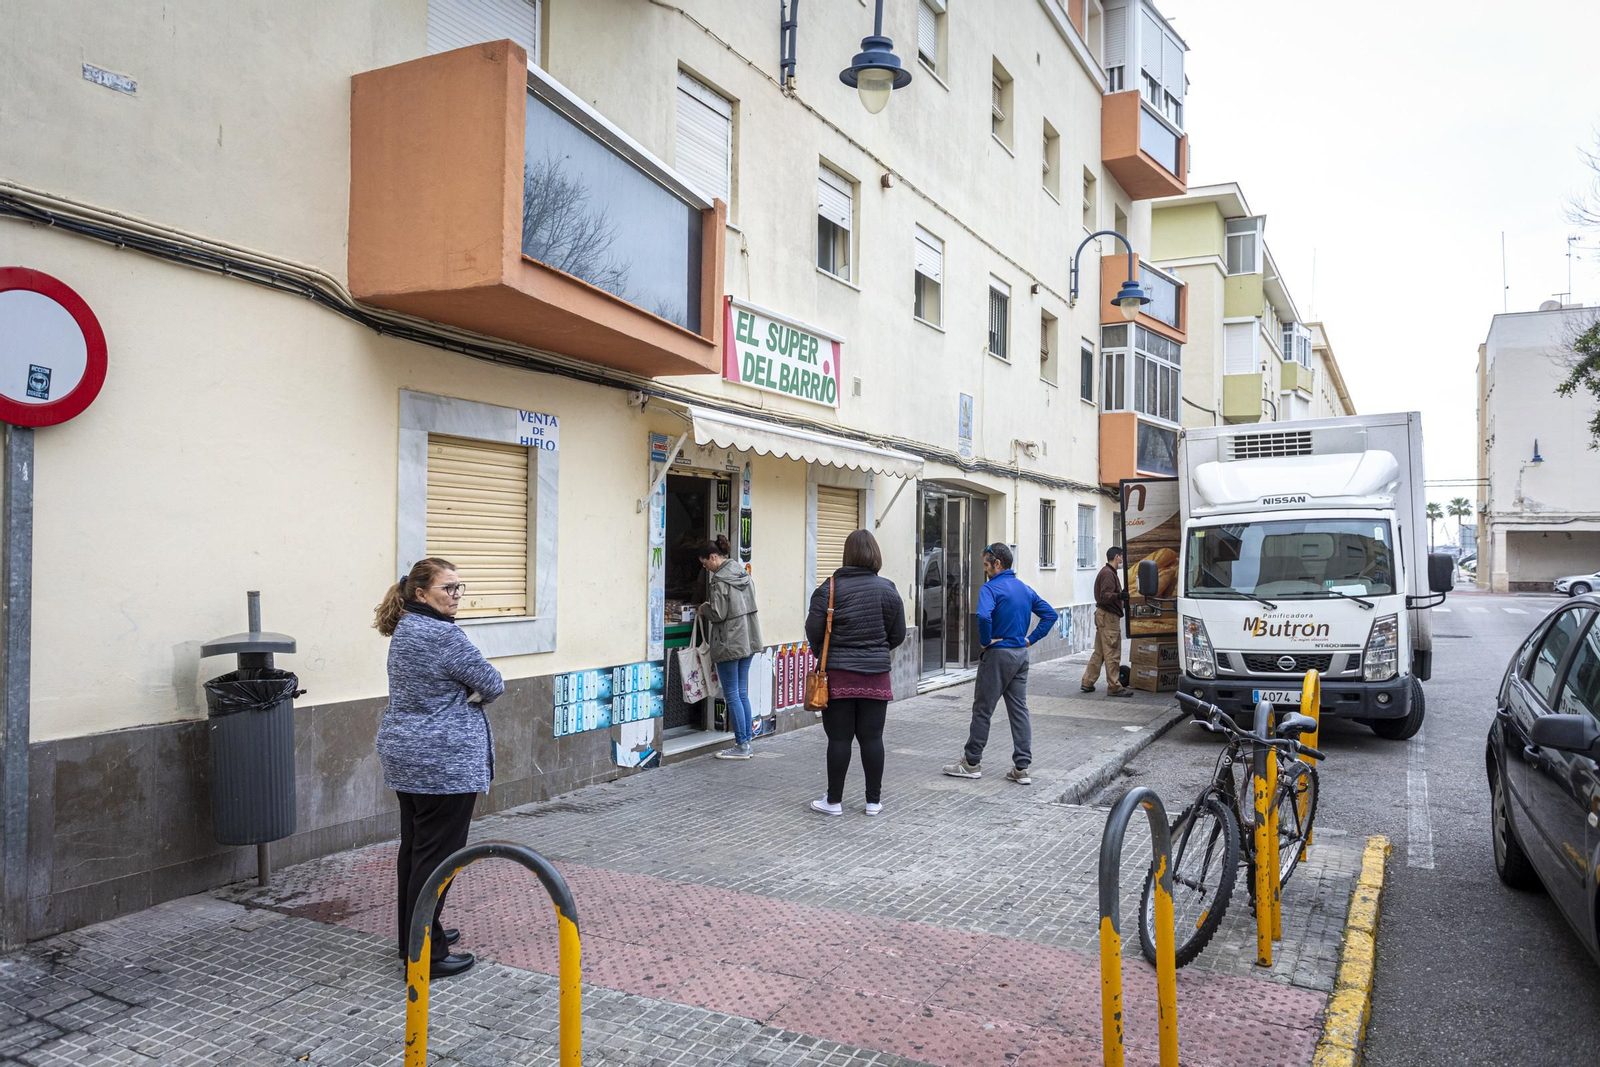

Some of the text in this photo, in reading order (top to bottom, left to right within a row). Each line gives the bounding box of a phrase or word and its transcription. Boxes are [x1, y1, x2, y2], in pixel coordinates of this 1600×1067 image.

[736, 310, 819, 366] EL SUPER
[742, 351, 837, 404] DEL BARRIO
[519, 410, 558, 428] VENTA
[532, 427, 545, 436] DE
[1263, 496, 1306, 505] NISSAN
[1261, 692, 1291, 703] 4074
